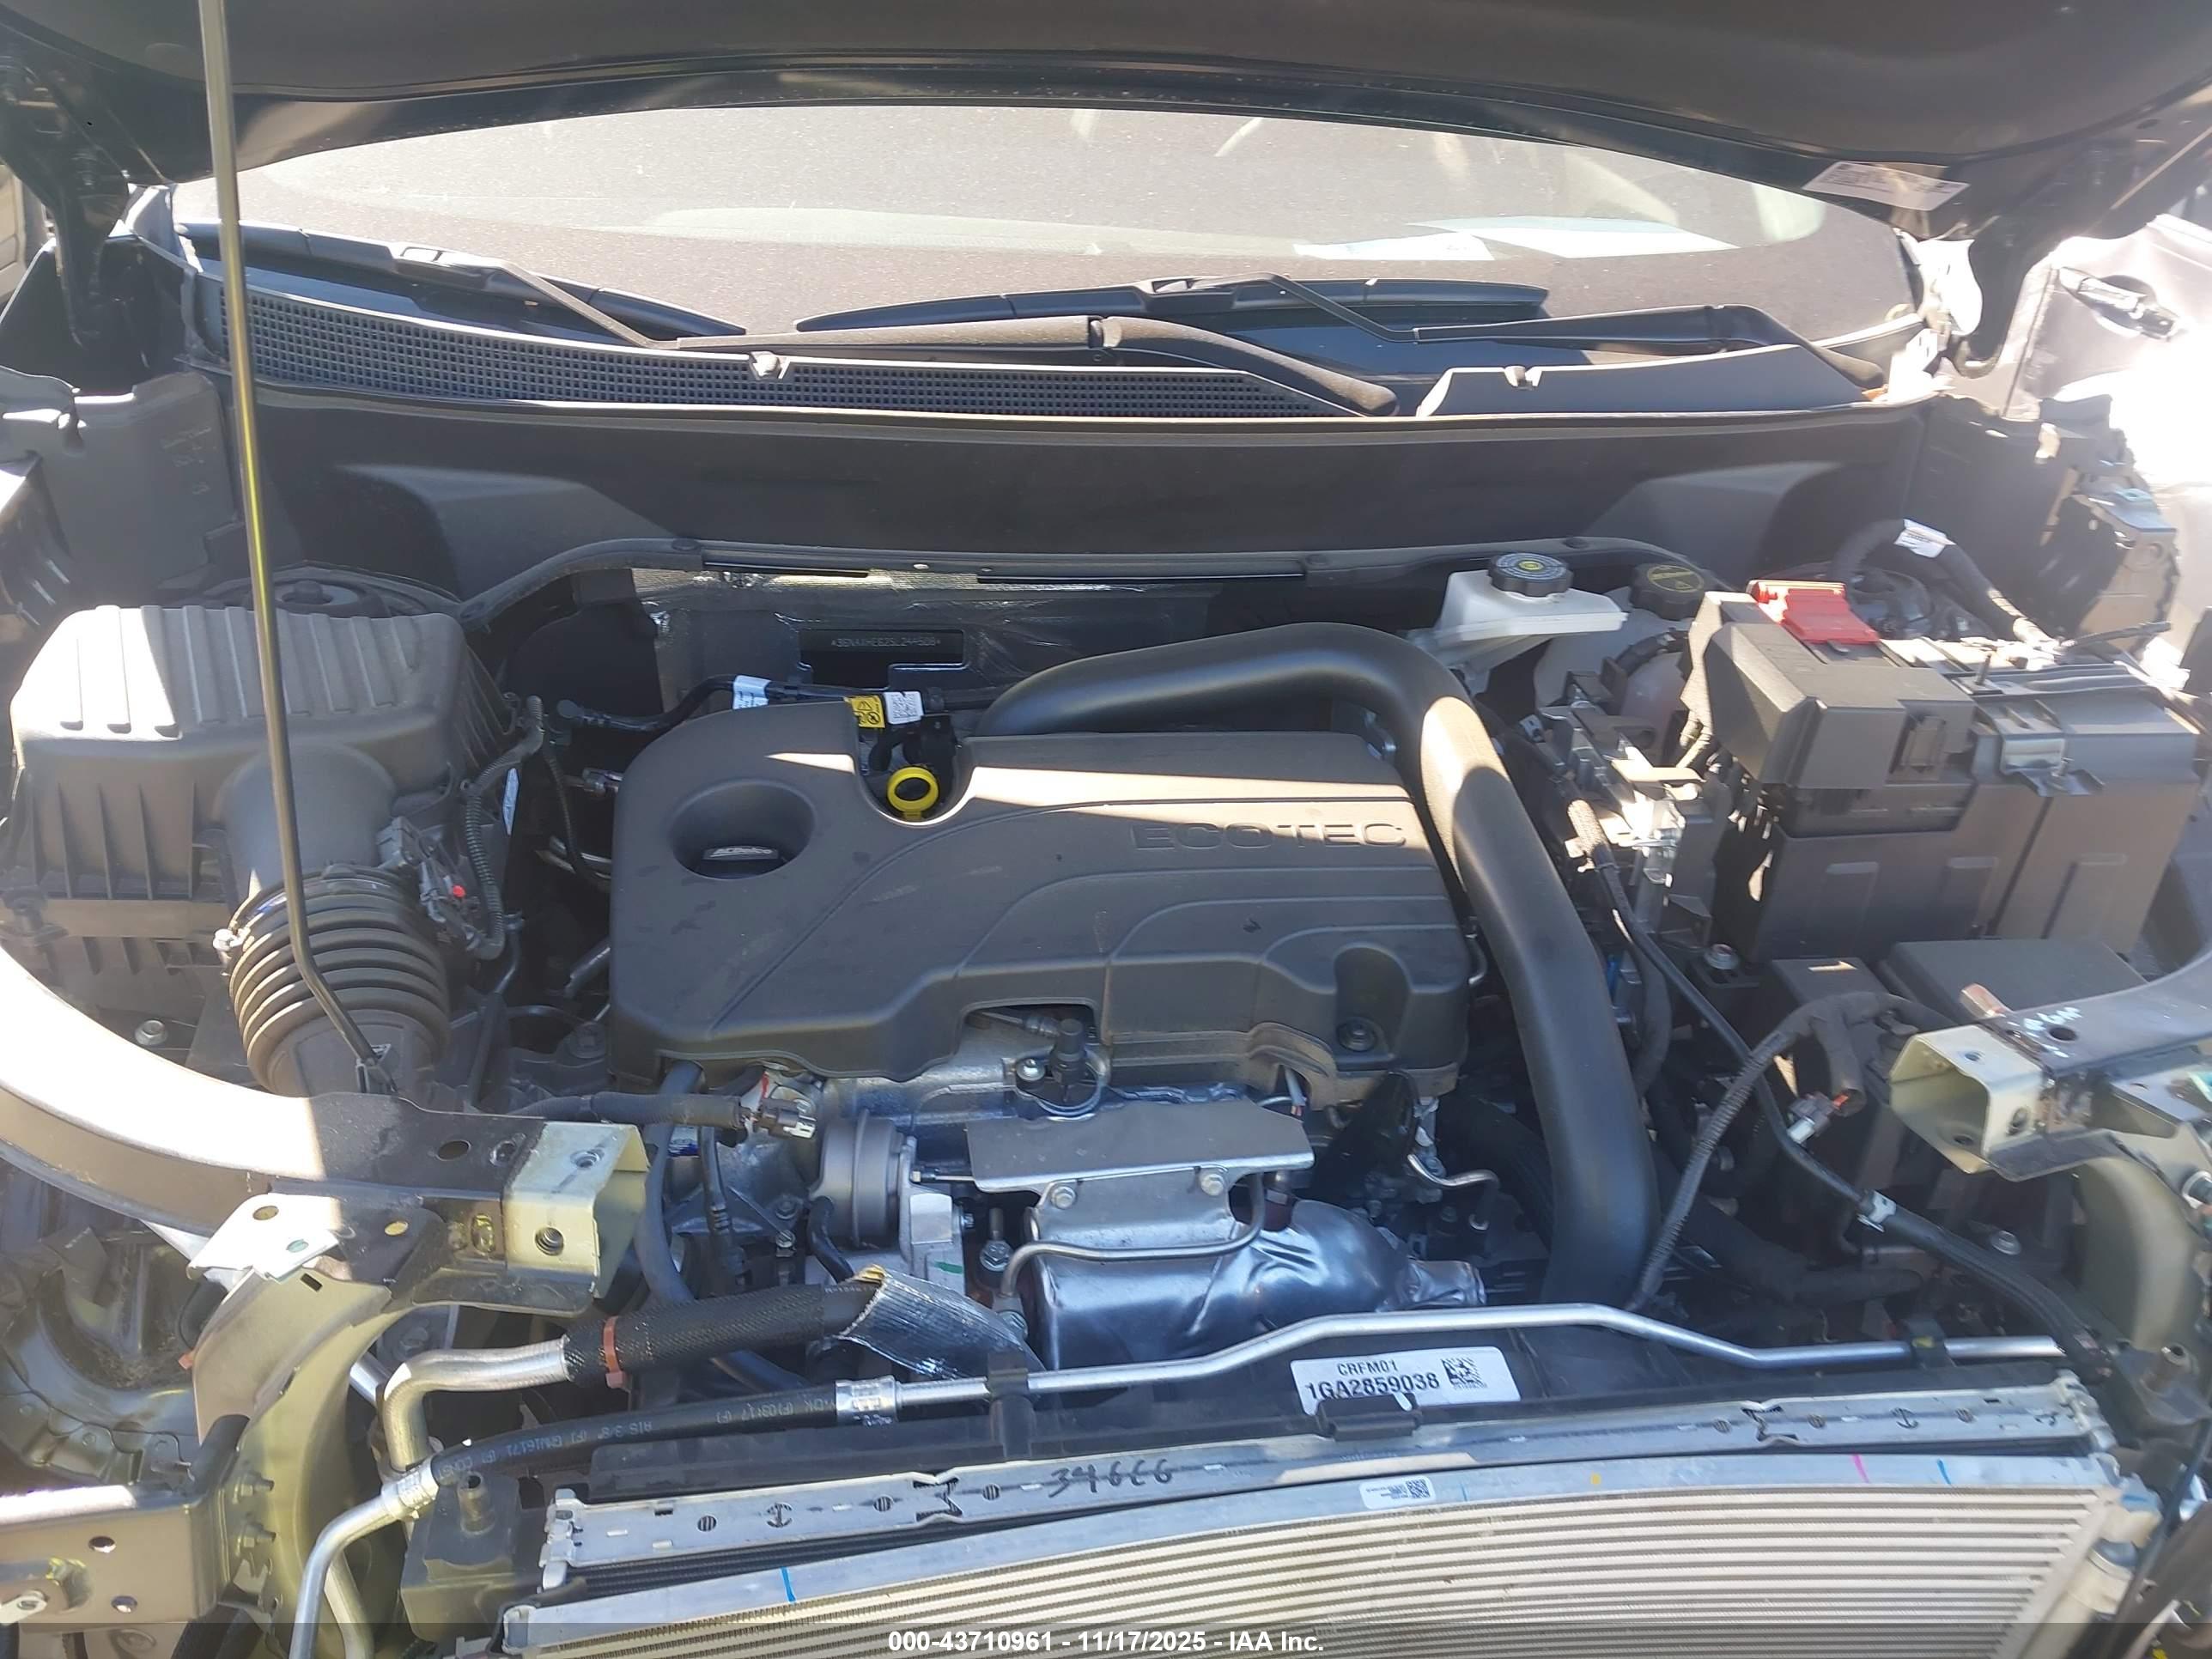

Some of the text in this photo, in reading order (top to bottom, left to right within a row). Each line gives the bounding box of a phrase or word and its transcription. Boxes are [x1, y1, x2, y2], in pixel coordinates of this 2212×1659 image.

[1131, 822, 1407, 850] ECOTEC
[1337, 1359, 1397, 1376] CRFM01
[1305, 1372, 1439, 1400] 1GA2859038
